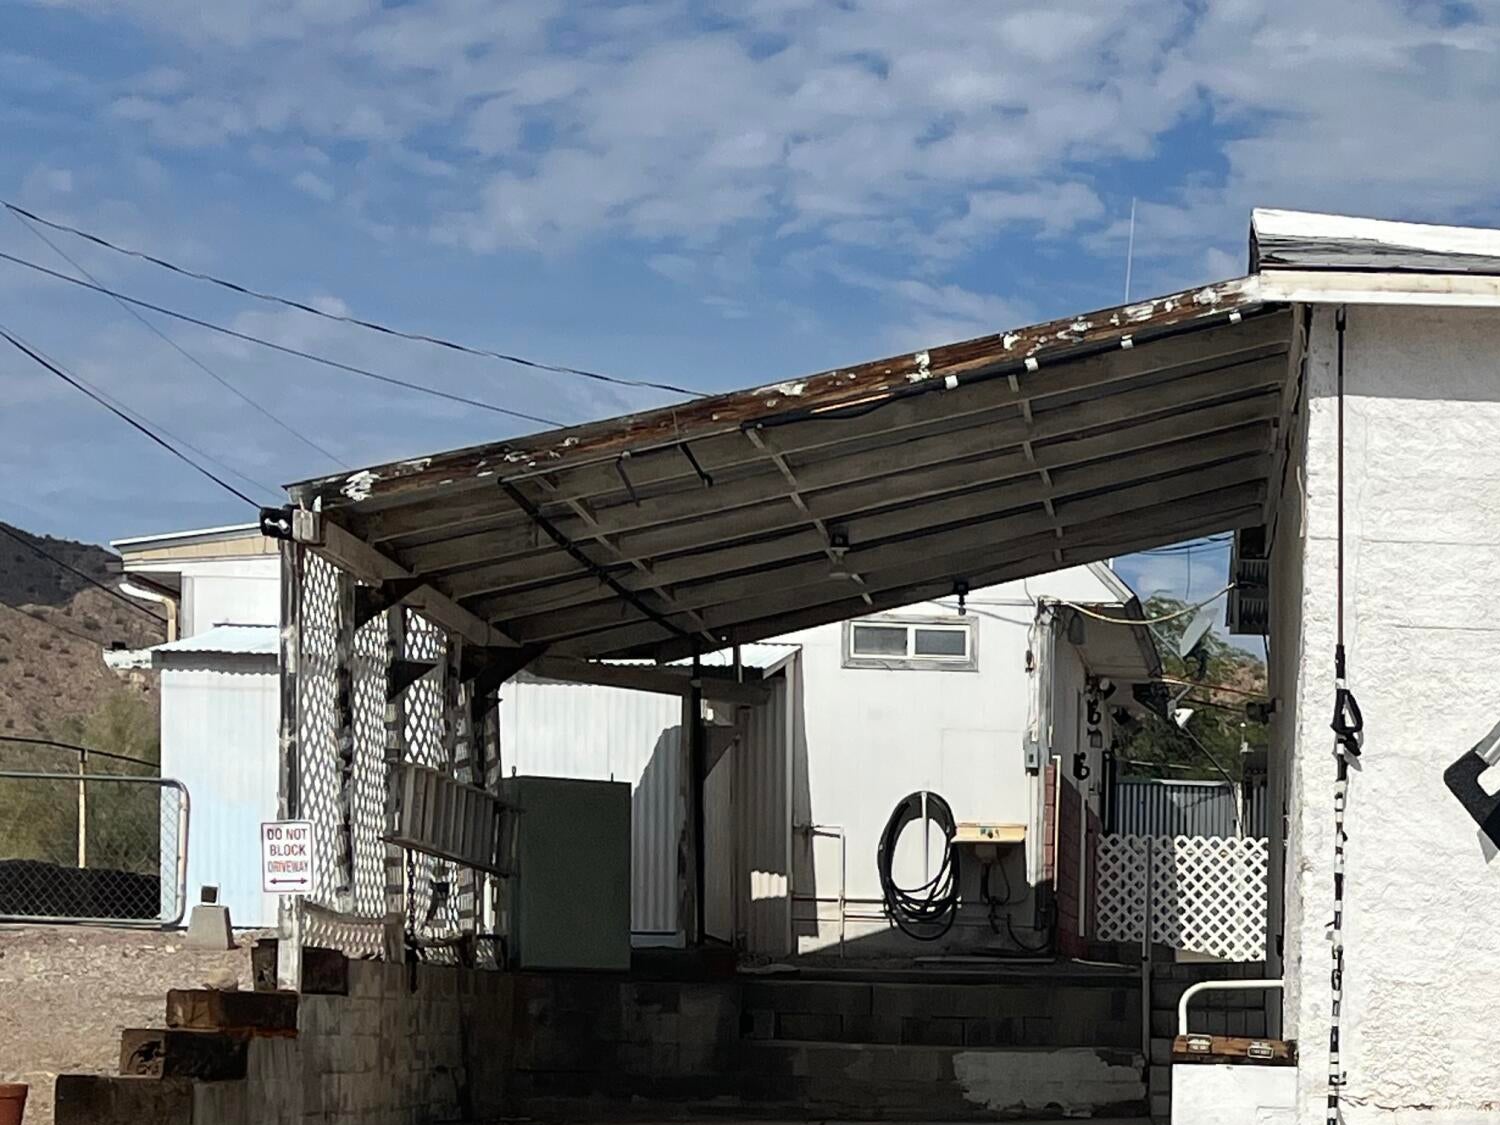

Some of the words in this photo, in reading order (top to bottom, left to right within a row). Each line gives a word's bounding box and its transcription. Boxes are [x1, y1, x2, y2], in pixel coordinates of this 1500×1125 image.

[266, 827, 283, 841] DO
[286, 828, 308, 841] NOT
[269, 844, 307, 857] BLOCK
[267, 860, 308, 873] DRIVEWAY
